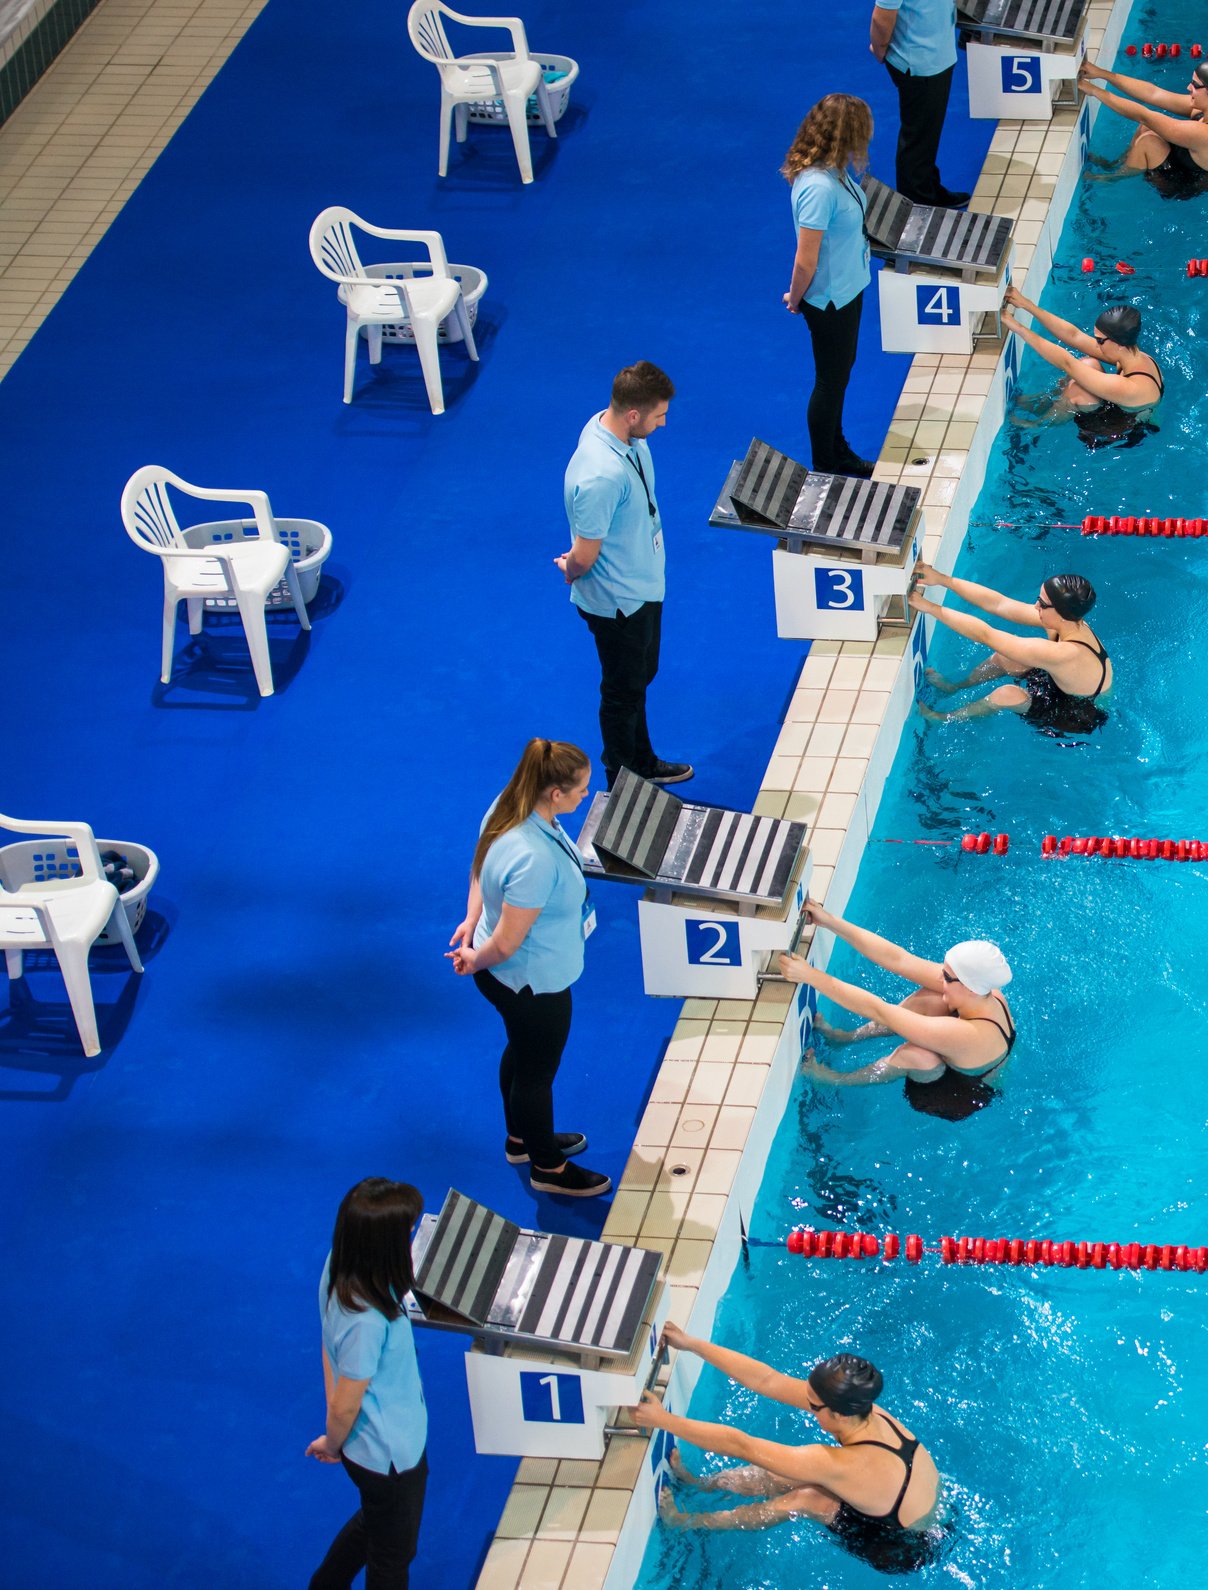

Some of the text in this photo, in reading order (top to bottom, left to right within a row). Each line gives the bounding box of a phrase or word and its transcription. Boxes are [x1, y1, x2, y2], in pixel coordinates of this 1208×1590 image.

[1011, 57, 1033, 91] 5
[924, 288, 953, 323] 4
[828, 571, 855, 608] 3
[698, 922, 731, 963] 2
[539, 1375, 562, 1420] 1
